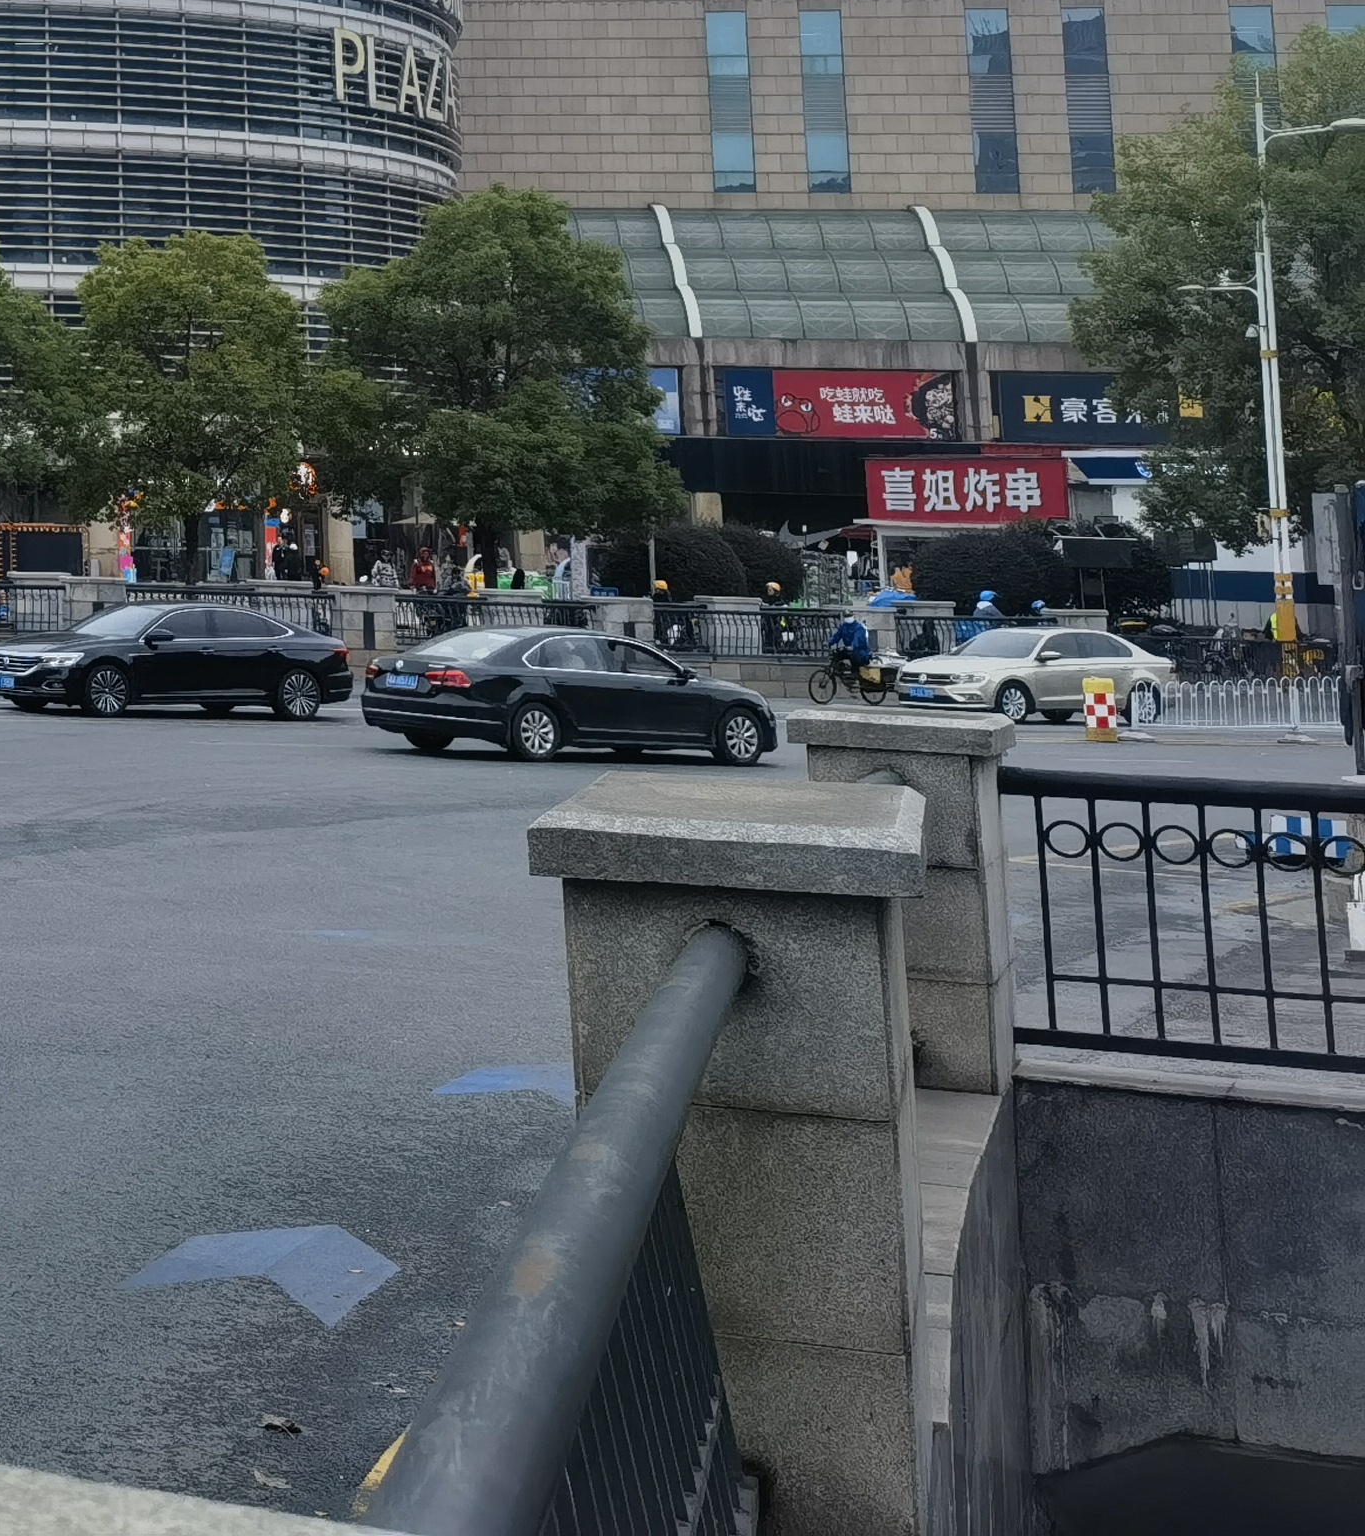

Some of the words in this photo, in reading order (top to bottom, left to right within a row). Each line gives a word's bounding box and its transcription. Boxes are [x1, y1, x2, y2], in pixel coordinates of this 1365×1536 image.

[332, 27, 458, 124] PLAZA
[819, 386, 885, 403] 吃蛙就吃
[832, 404, 896, 424] 蛙来哒
[881, 467, 1042, 513] 喜姐炸串
